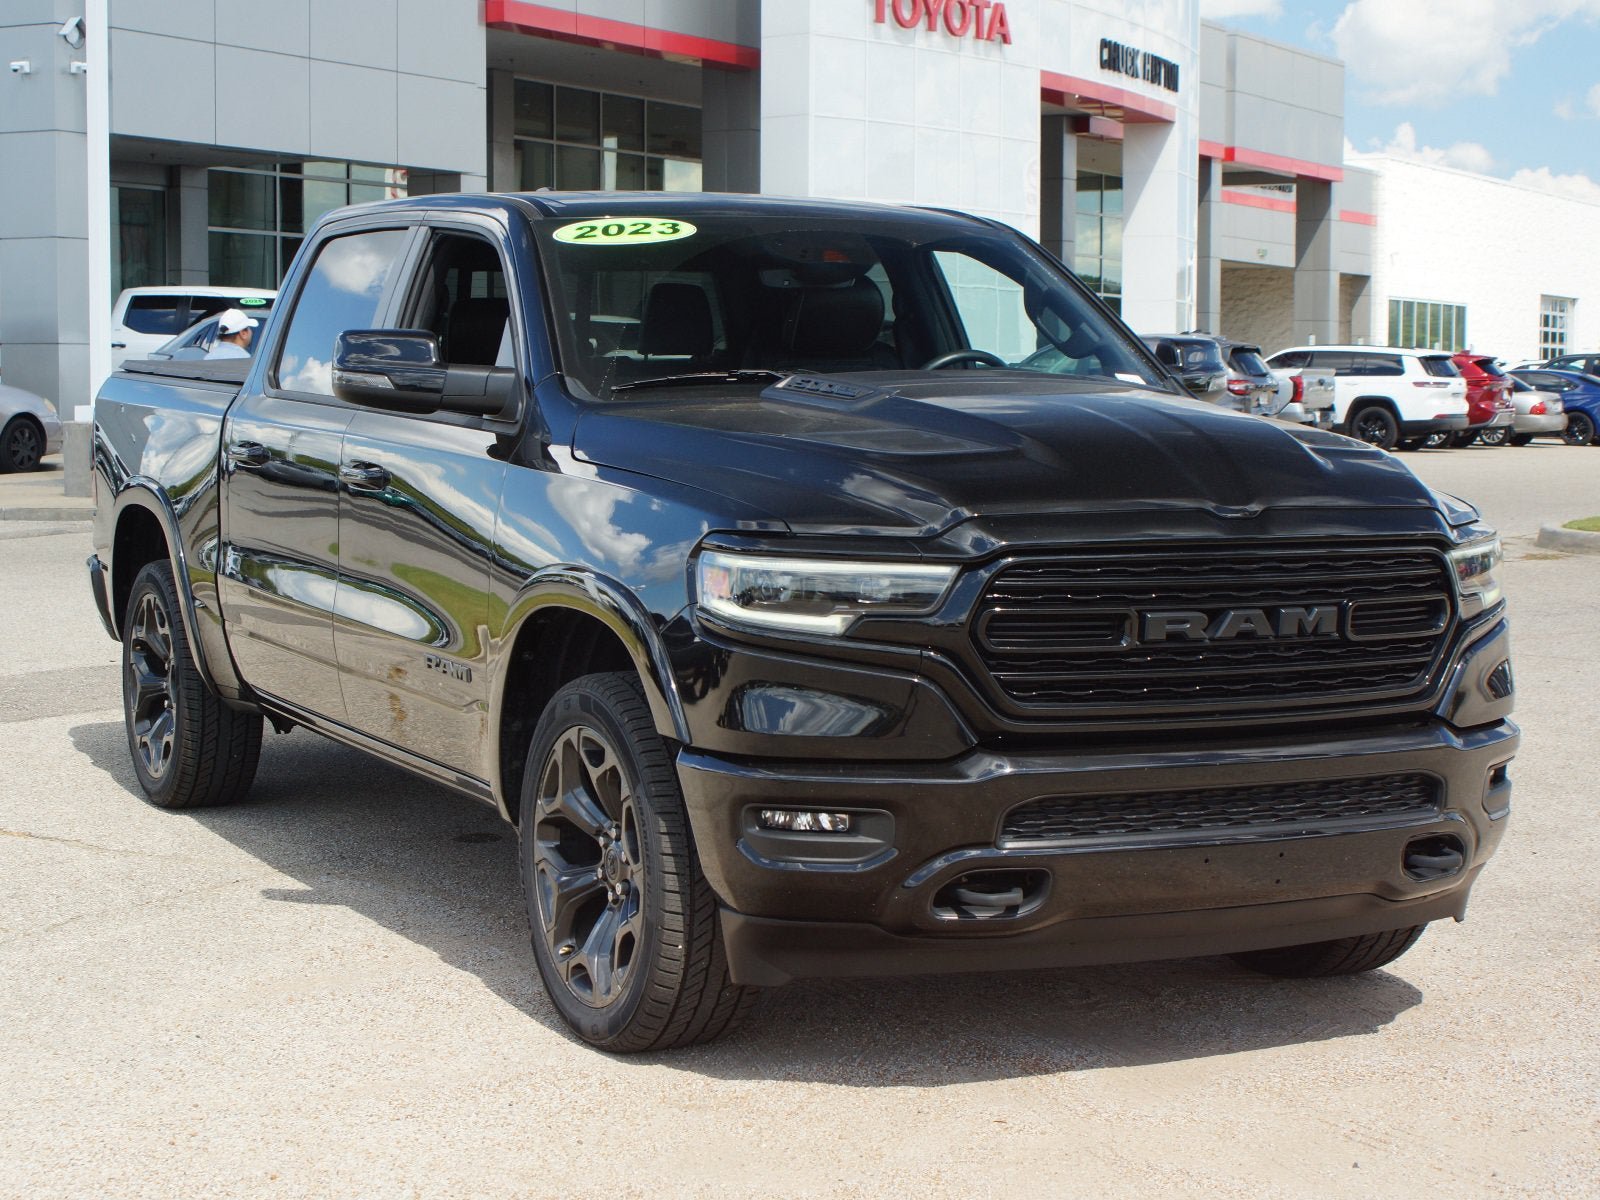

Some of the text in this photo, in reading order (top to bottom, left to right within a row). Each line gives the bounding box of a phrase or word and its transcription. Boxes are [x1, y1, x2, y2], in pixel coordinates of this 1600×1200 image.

[1100, 38, 1140, 79] CHUCK
[573, 222, 681, 240] 2023
[1143, 606, 1339, 642] RAM
[424, 653, 473, 683] RAM
